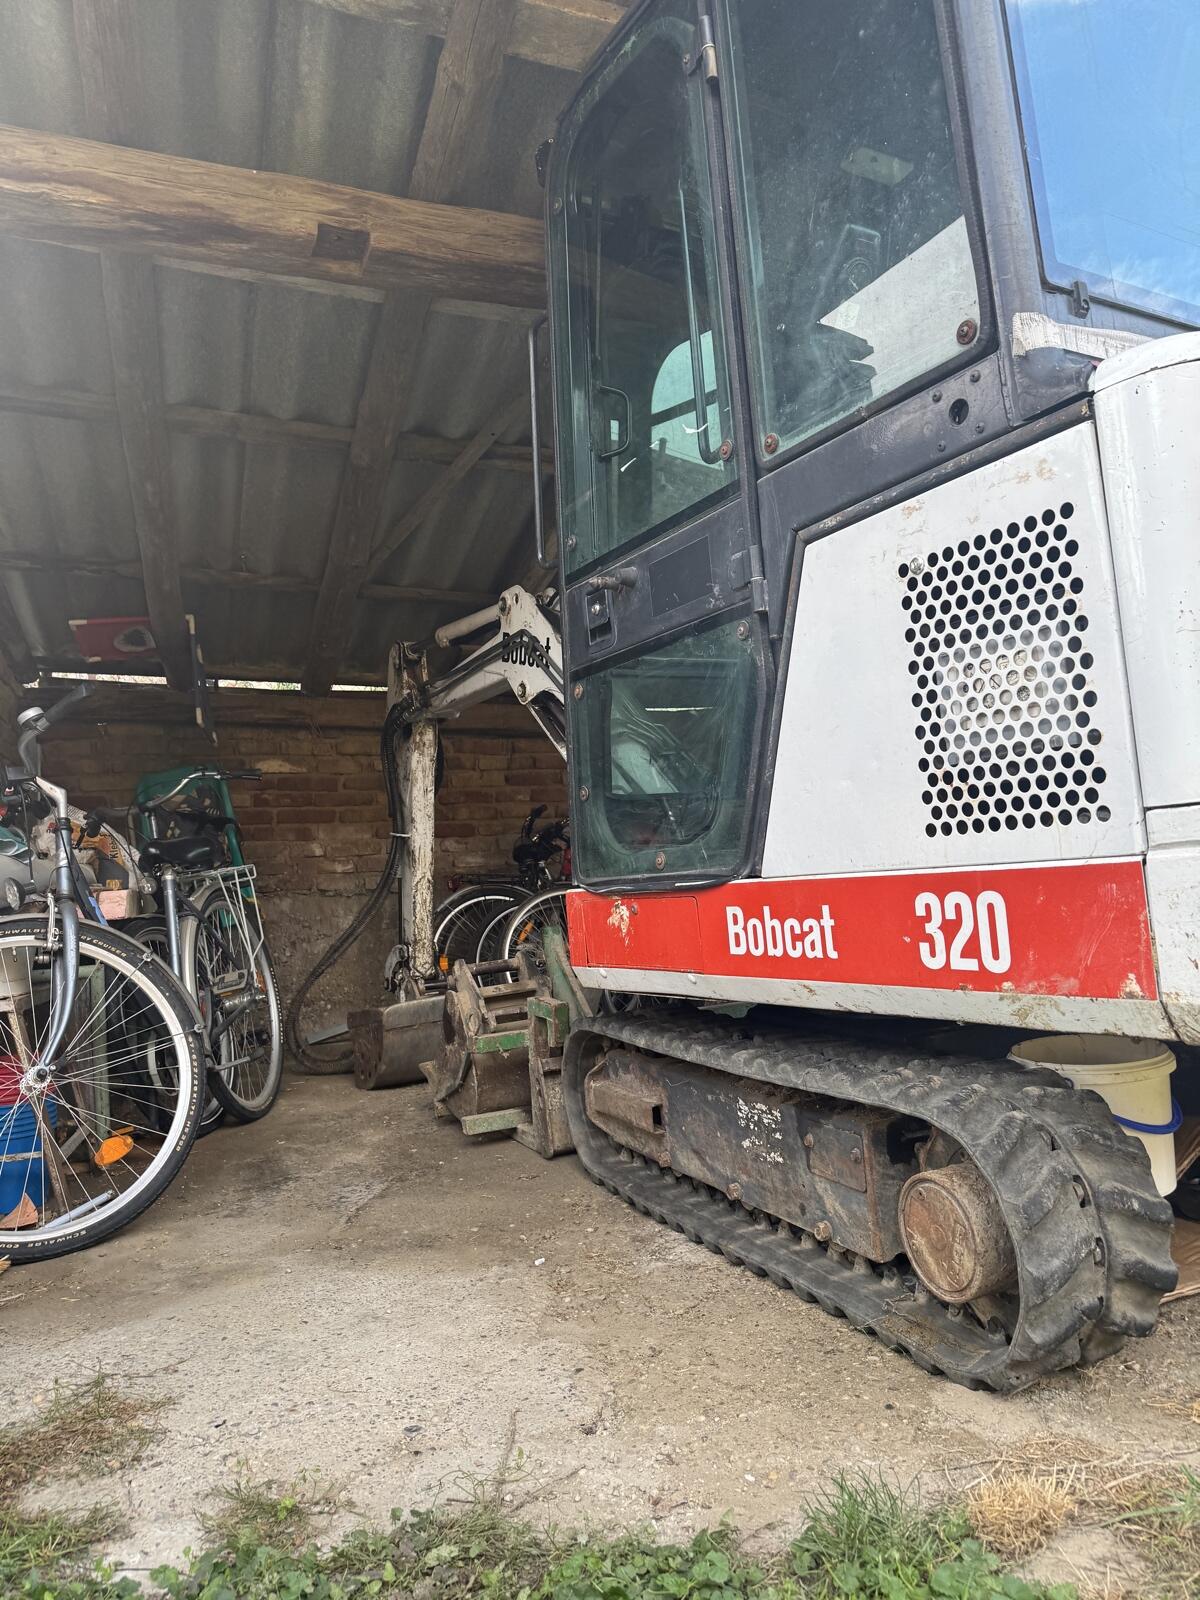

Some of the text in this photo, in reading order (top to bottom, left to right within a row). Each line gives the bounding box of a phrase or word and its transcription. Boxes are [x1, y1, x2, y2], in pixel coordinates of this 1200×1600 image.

[726, 891, 1011, 974] Bobcat 320
[27, 1229, 87, 1248] SCHWALBE
